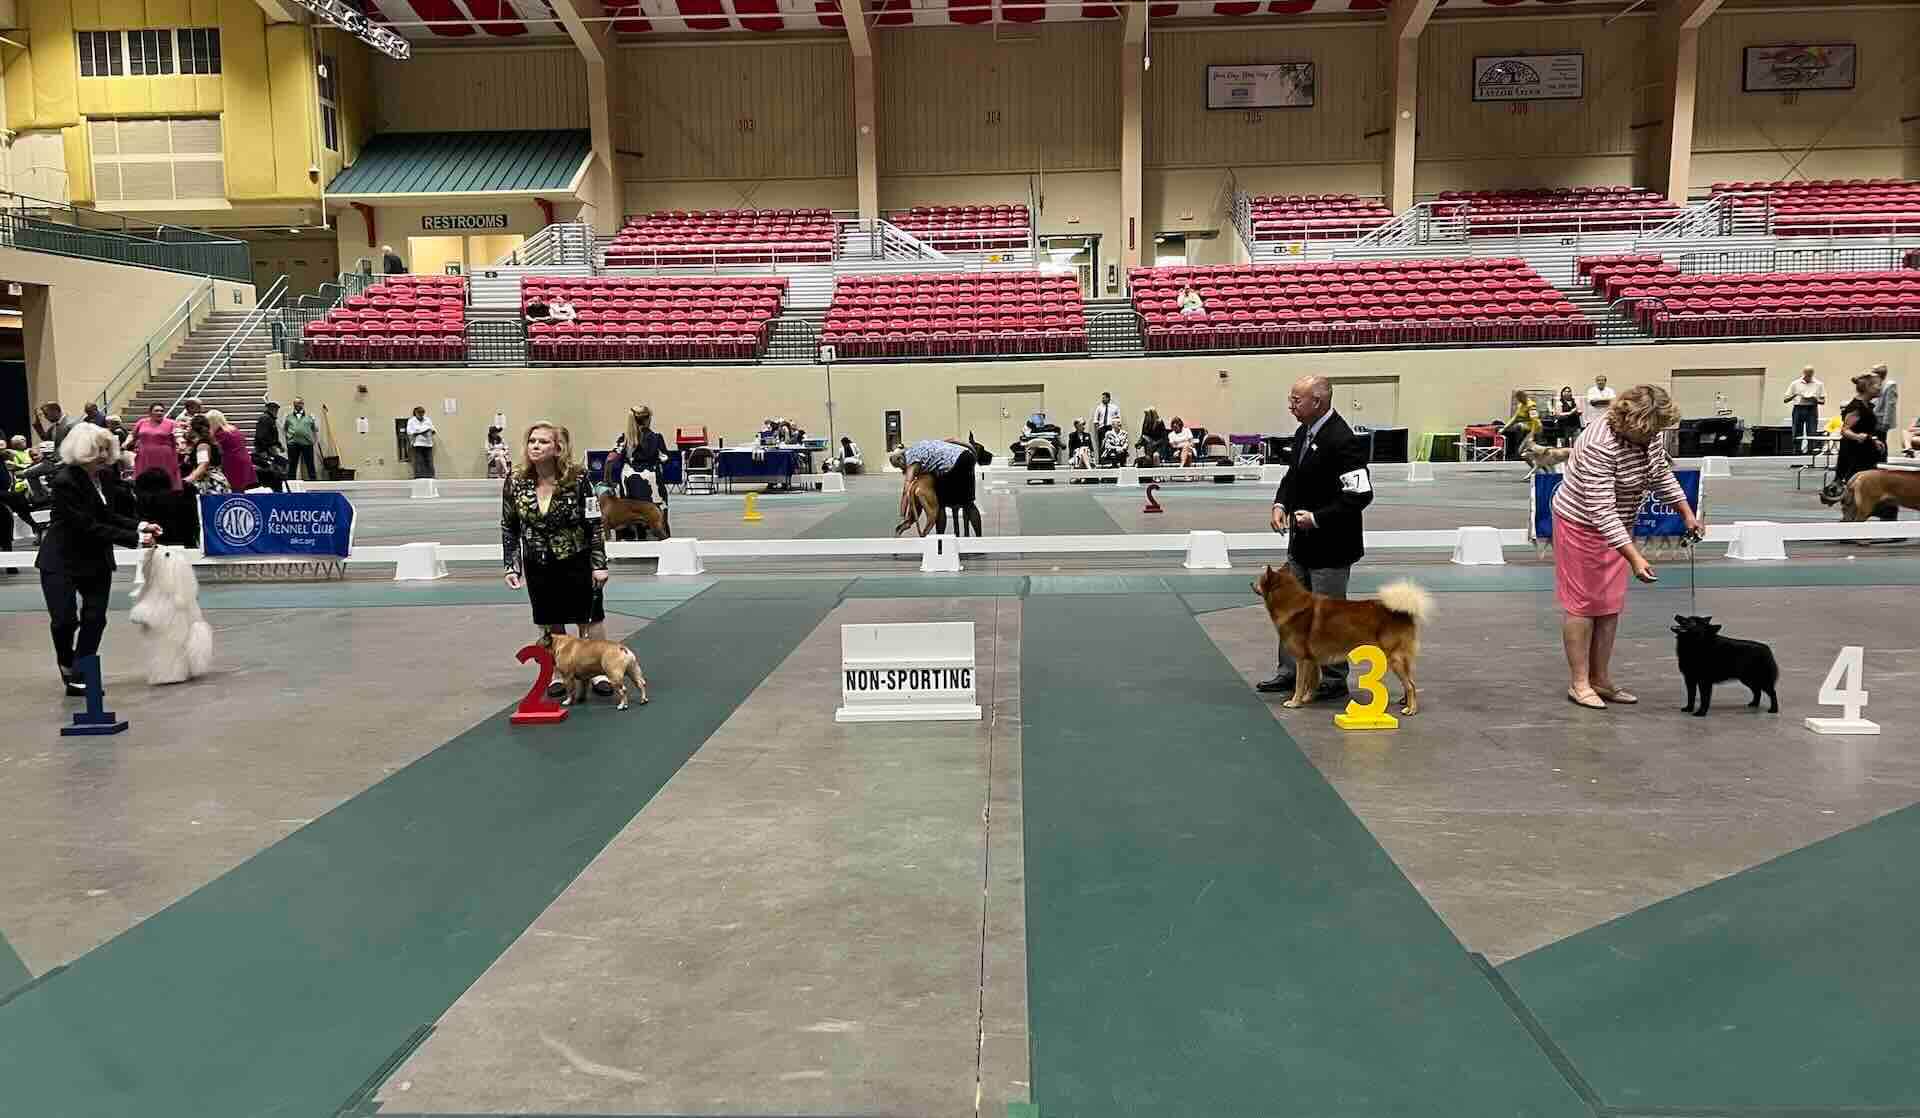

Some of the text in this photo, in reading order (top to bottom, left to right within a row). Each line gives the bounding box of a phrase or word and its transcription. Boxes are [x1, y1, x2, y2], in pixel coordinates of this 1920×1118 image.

[424, 215, 505, 229] RESTROOMS
[223, 507, 255, 538] AKC
[268, 508, 337, 523] AMERICAN
[1651, 503, 1680, 515] CLU
[268, 522, 309, 535] KENNEL
[73, 655, 116, 725] 1
[515, 645, 560, 714] 2
[846, 668, 972, 691] NON-SPORTING
[1345, 645, 1389, 714] 3
[1818, 646, 1869, 721] 4
